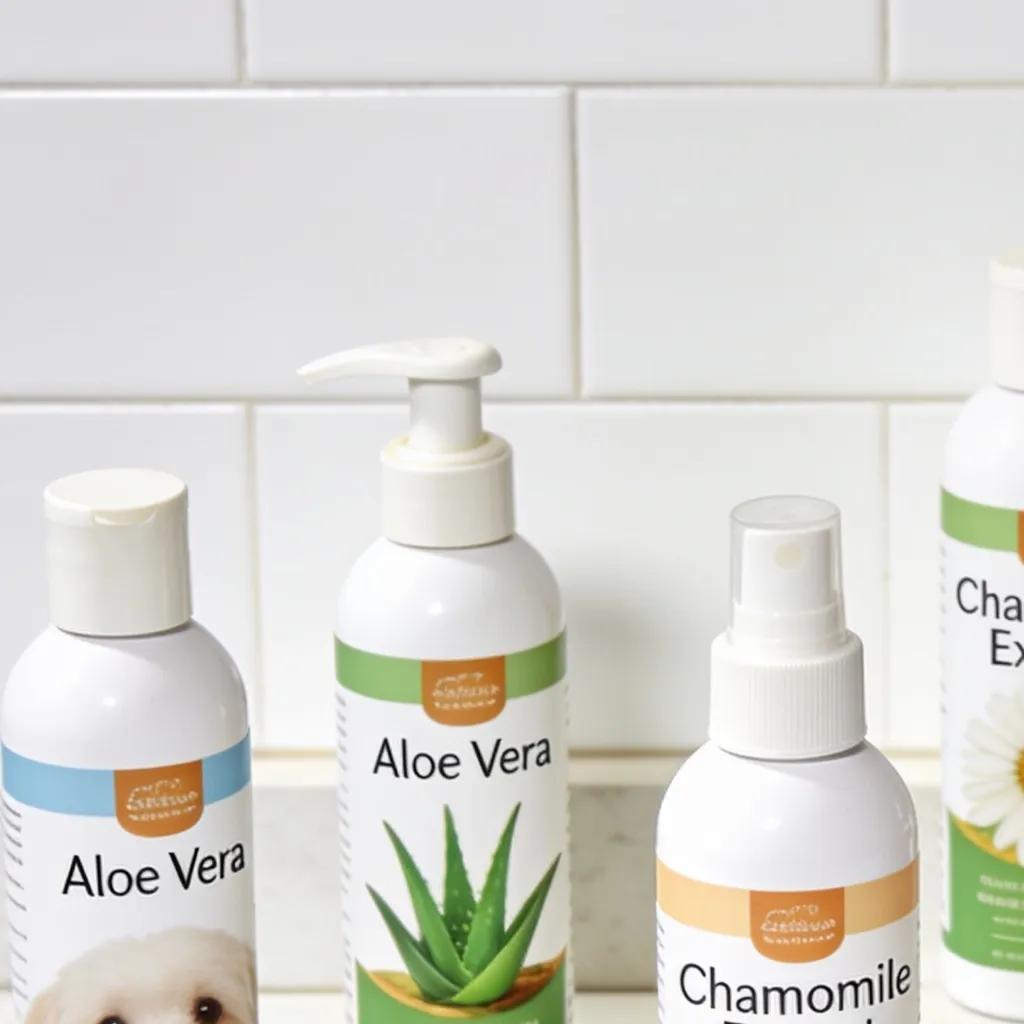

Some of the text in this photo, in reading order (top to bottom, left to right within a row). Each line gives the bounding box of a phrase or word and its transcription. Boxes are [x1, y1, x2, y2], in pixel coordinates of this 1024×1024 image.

[373, 737, 552, 780] Aloe Vera
[62, 842, 245, 897] Aloe Vera
[679, 958, 911, 1016] Chamomile
